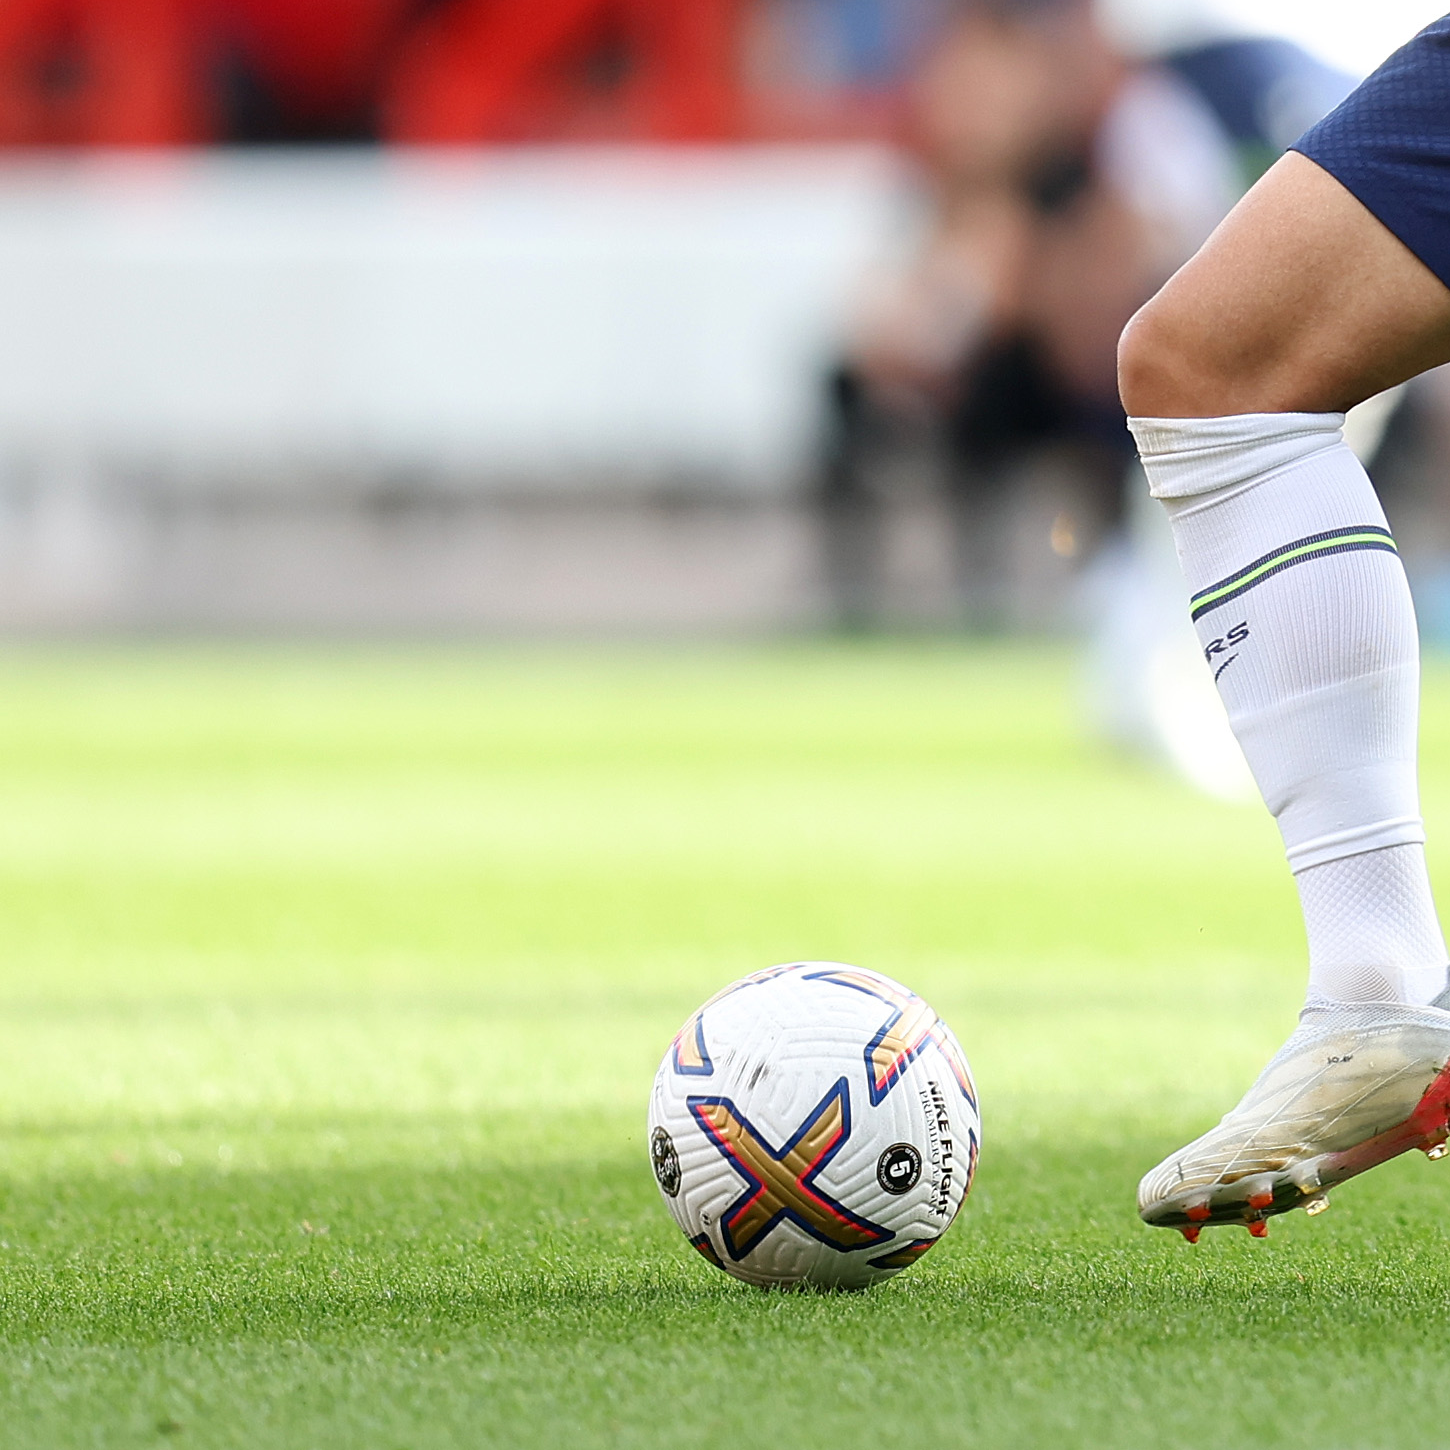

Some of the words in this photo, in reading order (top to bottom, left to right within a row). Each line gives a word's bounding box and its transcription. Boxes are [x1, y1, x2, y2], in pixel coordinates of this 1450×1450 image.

[918, 1090, 940, 1159] PREMIER
[927, 1080, 951, 1133] NIKE
[889, 1160, 911, 1178] 5
[926, 1158, 942, 1219] LEAGUE
[935, 1139, 953, 1220] FLIGHT
